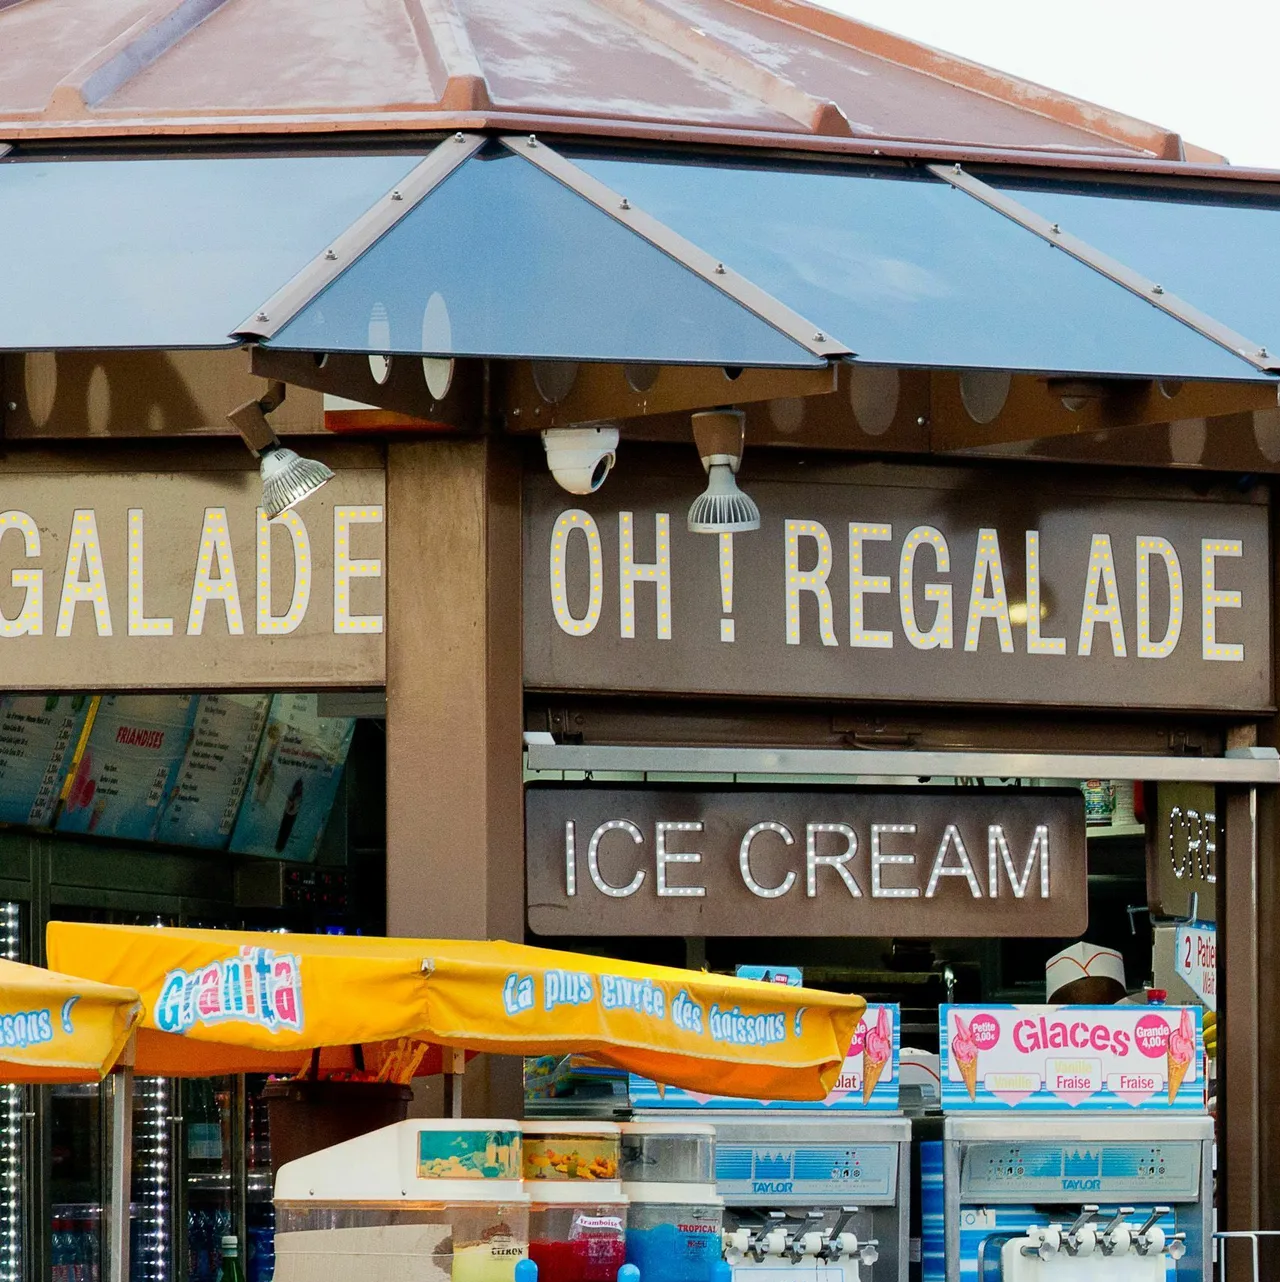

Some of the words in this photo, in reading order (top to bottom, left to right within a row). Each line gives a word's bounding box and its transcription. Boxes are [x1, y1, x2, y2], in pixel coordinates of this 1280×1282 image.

[0, 505, 384, 638] GALADE
[549, 508, 672, 640] OH
[718, 532, 736, 643] !
[784, 518, 1244, 662] REGALADE
[116, 726, 164, 750] FRIANDISES
[565, 819, 706, 897] ICE
[739, 820, 1050, 898] CREAM
[1185, 936, 1192, 969] 2
[1197, 937, 1216, 969] Patie
[156, 945, 303, 1032] Granita
[503, 973, 534, 1016] La
[544, 968, 594, 1011] plus
[601, 974, 665, 1019] givrée
[671, 988, 704, 1034] des
[708, 1003, 786, 1046] boissons
[972, 1022, 996, 1033] Petite
[1136, 1025, 1170, 1038] Grande
[975, 1032, 995, 1042] 3,00€
[1012, 1016, 1131, 1057] Glaces
[1142, 1036, 1166, 1048] 4,00€
[1054, 1060, 1093, 1074] Vanille
[994, 1075, 1034, 1089] Vanille
[1056, 1075, 1091, 1089] Fraise
[1120, 1075, 1154, 1089] Fraise
[752, 1182, 793, 1193] TAYLOR
[1062, 1179, 1101, 1190] TAYLOR
[580, 1217, 619, 1228] Framboise
[677, 1224, 718, 1233] TROPICAL
[491, 1247, 524, 1257] CITRON
